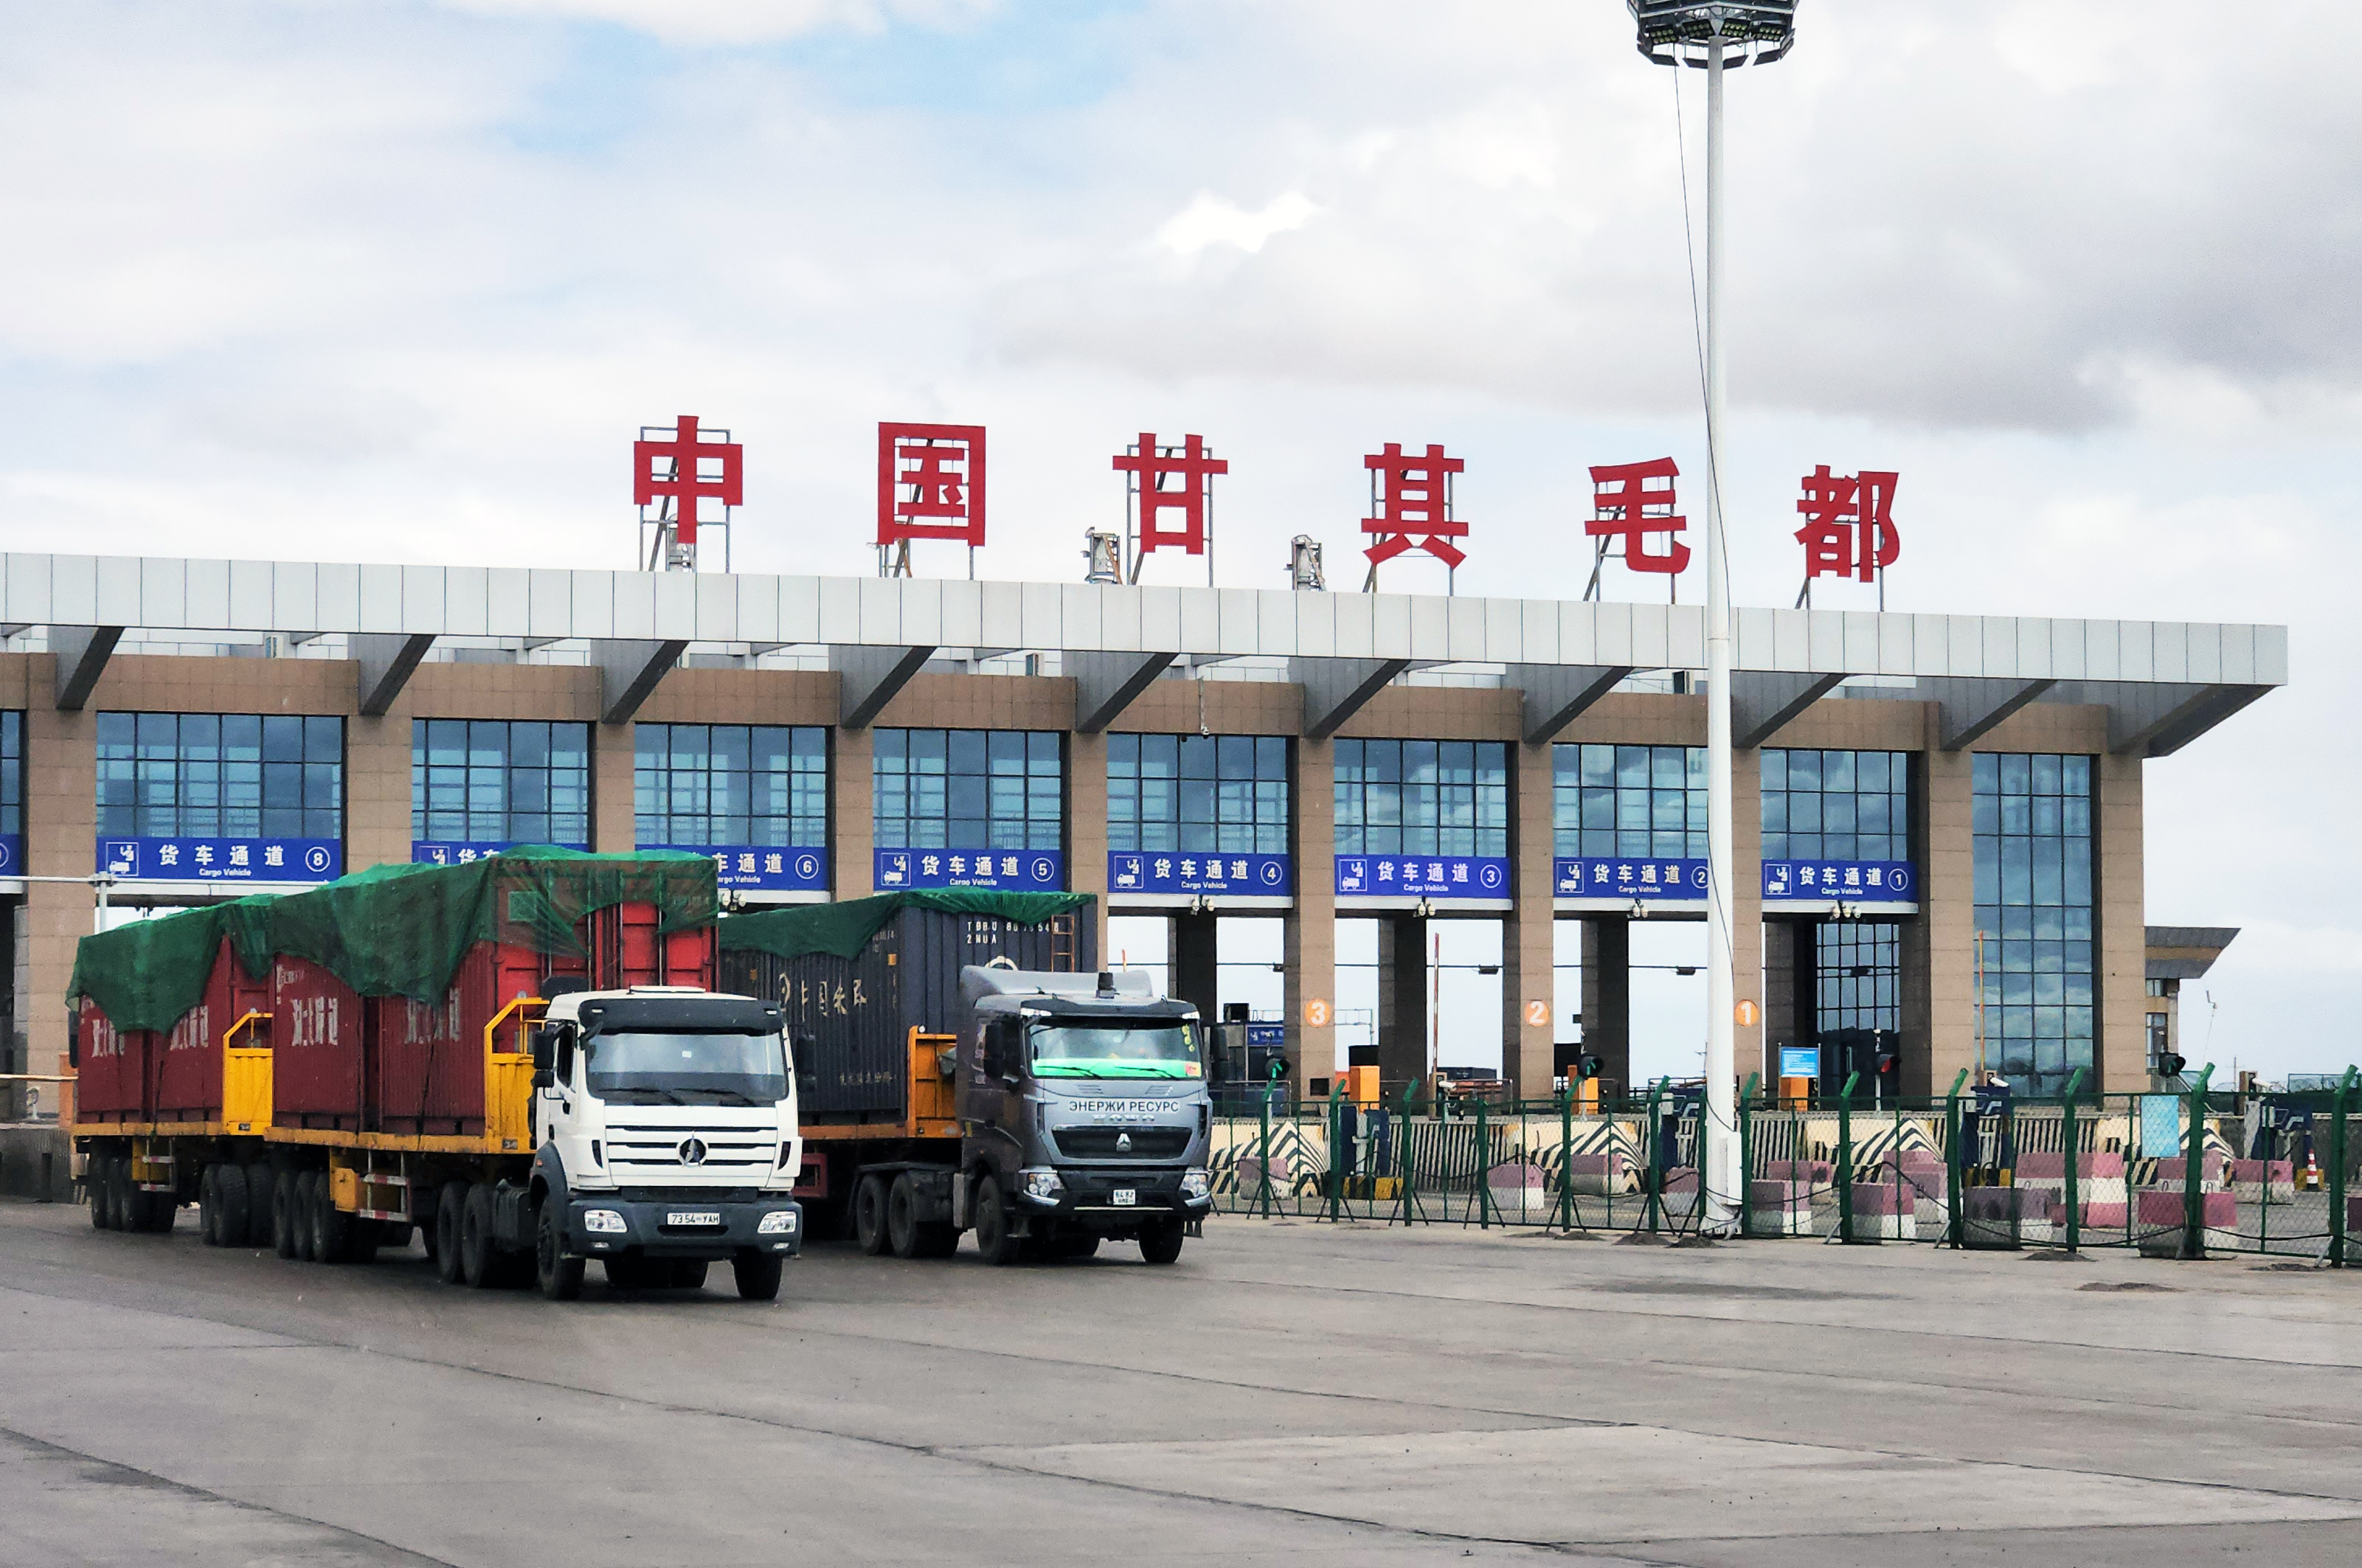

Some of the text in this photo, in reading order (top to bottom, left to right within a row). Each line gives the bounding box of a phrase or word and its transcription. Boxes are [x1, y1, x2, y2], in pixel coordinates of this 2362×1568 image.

[634, 415, 1900, 583] 中国甘其毛都
[159, 844, 323, 867] 货车通道 8
[692, 852, 812, 873] 车通道 6
[199, 868, 251, 878] Cargo Vehicle
[921, 856, 1047, 876] 货车通道 5
[1154, 858, 1276, 880] 货车通道 4
[1377, 861, 1495, 883] 货车通道 3
[1593, 864, 1706, 884] 货车通道 2
[734, 875, 761, 884] Vehicle
[972, 878, 997, 886] Vehicle
[1181, 881, 1201, 889] Cargo
[1800, 867, 1902, 886] 货车通道 1
[1404, 884, 1422, 892] Cargo
[1618, 885, 1637, 894] Cargo
[1821, 887, 1840, 895] Cargo
[1311, 1002, 1325, 1024] 3
[1529, 1001, 1546, 1024] 2
[1741, 1002, 1751, 1024] 1
[1069, 1100, 1179, 1112] ЭНЕРЖИ РЕСУРС
